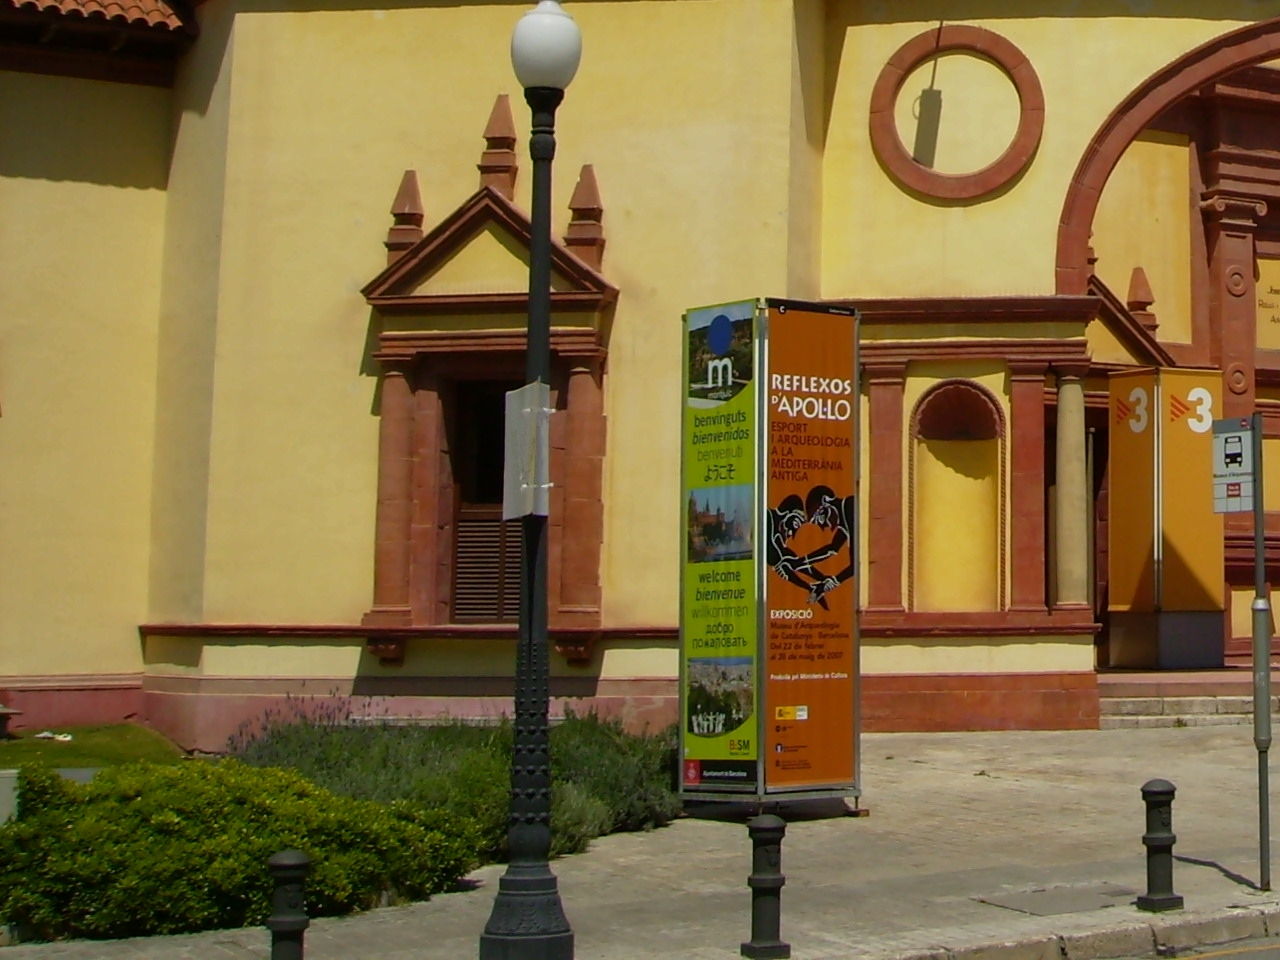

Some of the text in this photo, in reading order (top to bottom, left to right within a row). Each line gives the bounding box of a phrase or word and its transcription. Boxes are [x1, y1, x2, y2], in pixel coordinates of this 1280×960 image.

[772, 373, 852, 395] REFLEXOS
[1129, 387, 1148, 433] 3
[1187, 387, 1213, 433] 3
[694, 411, 747, 428] benvinguts
[771, 421, 809, 433] ESPORT
[692, 427, 749, 445] bienvenidos
[779, 434, 851, 448] ARQUEOLOGIA
[771, 446, 794, 457] A LA
[704, 463, 737, 482] ようこそ
[771, 470, 809, 482] ANTIGA
[698, 570, 742, 583] welcome
[695, 587, 747, 601] bienvenue
[770, 608, 813, 619] EXPOSICIÓ
[705, 622, 734, 636] добро
